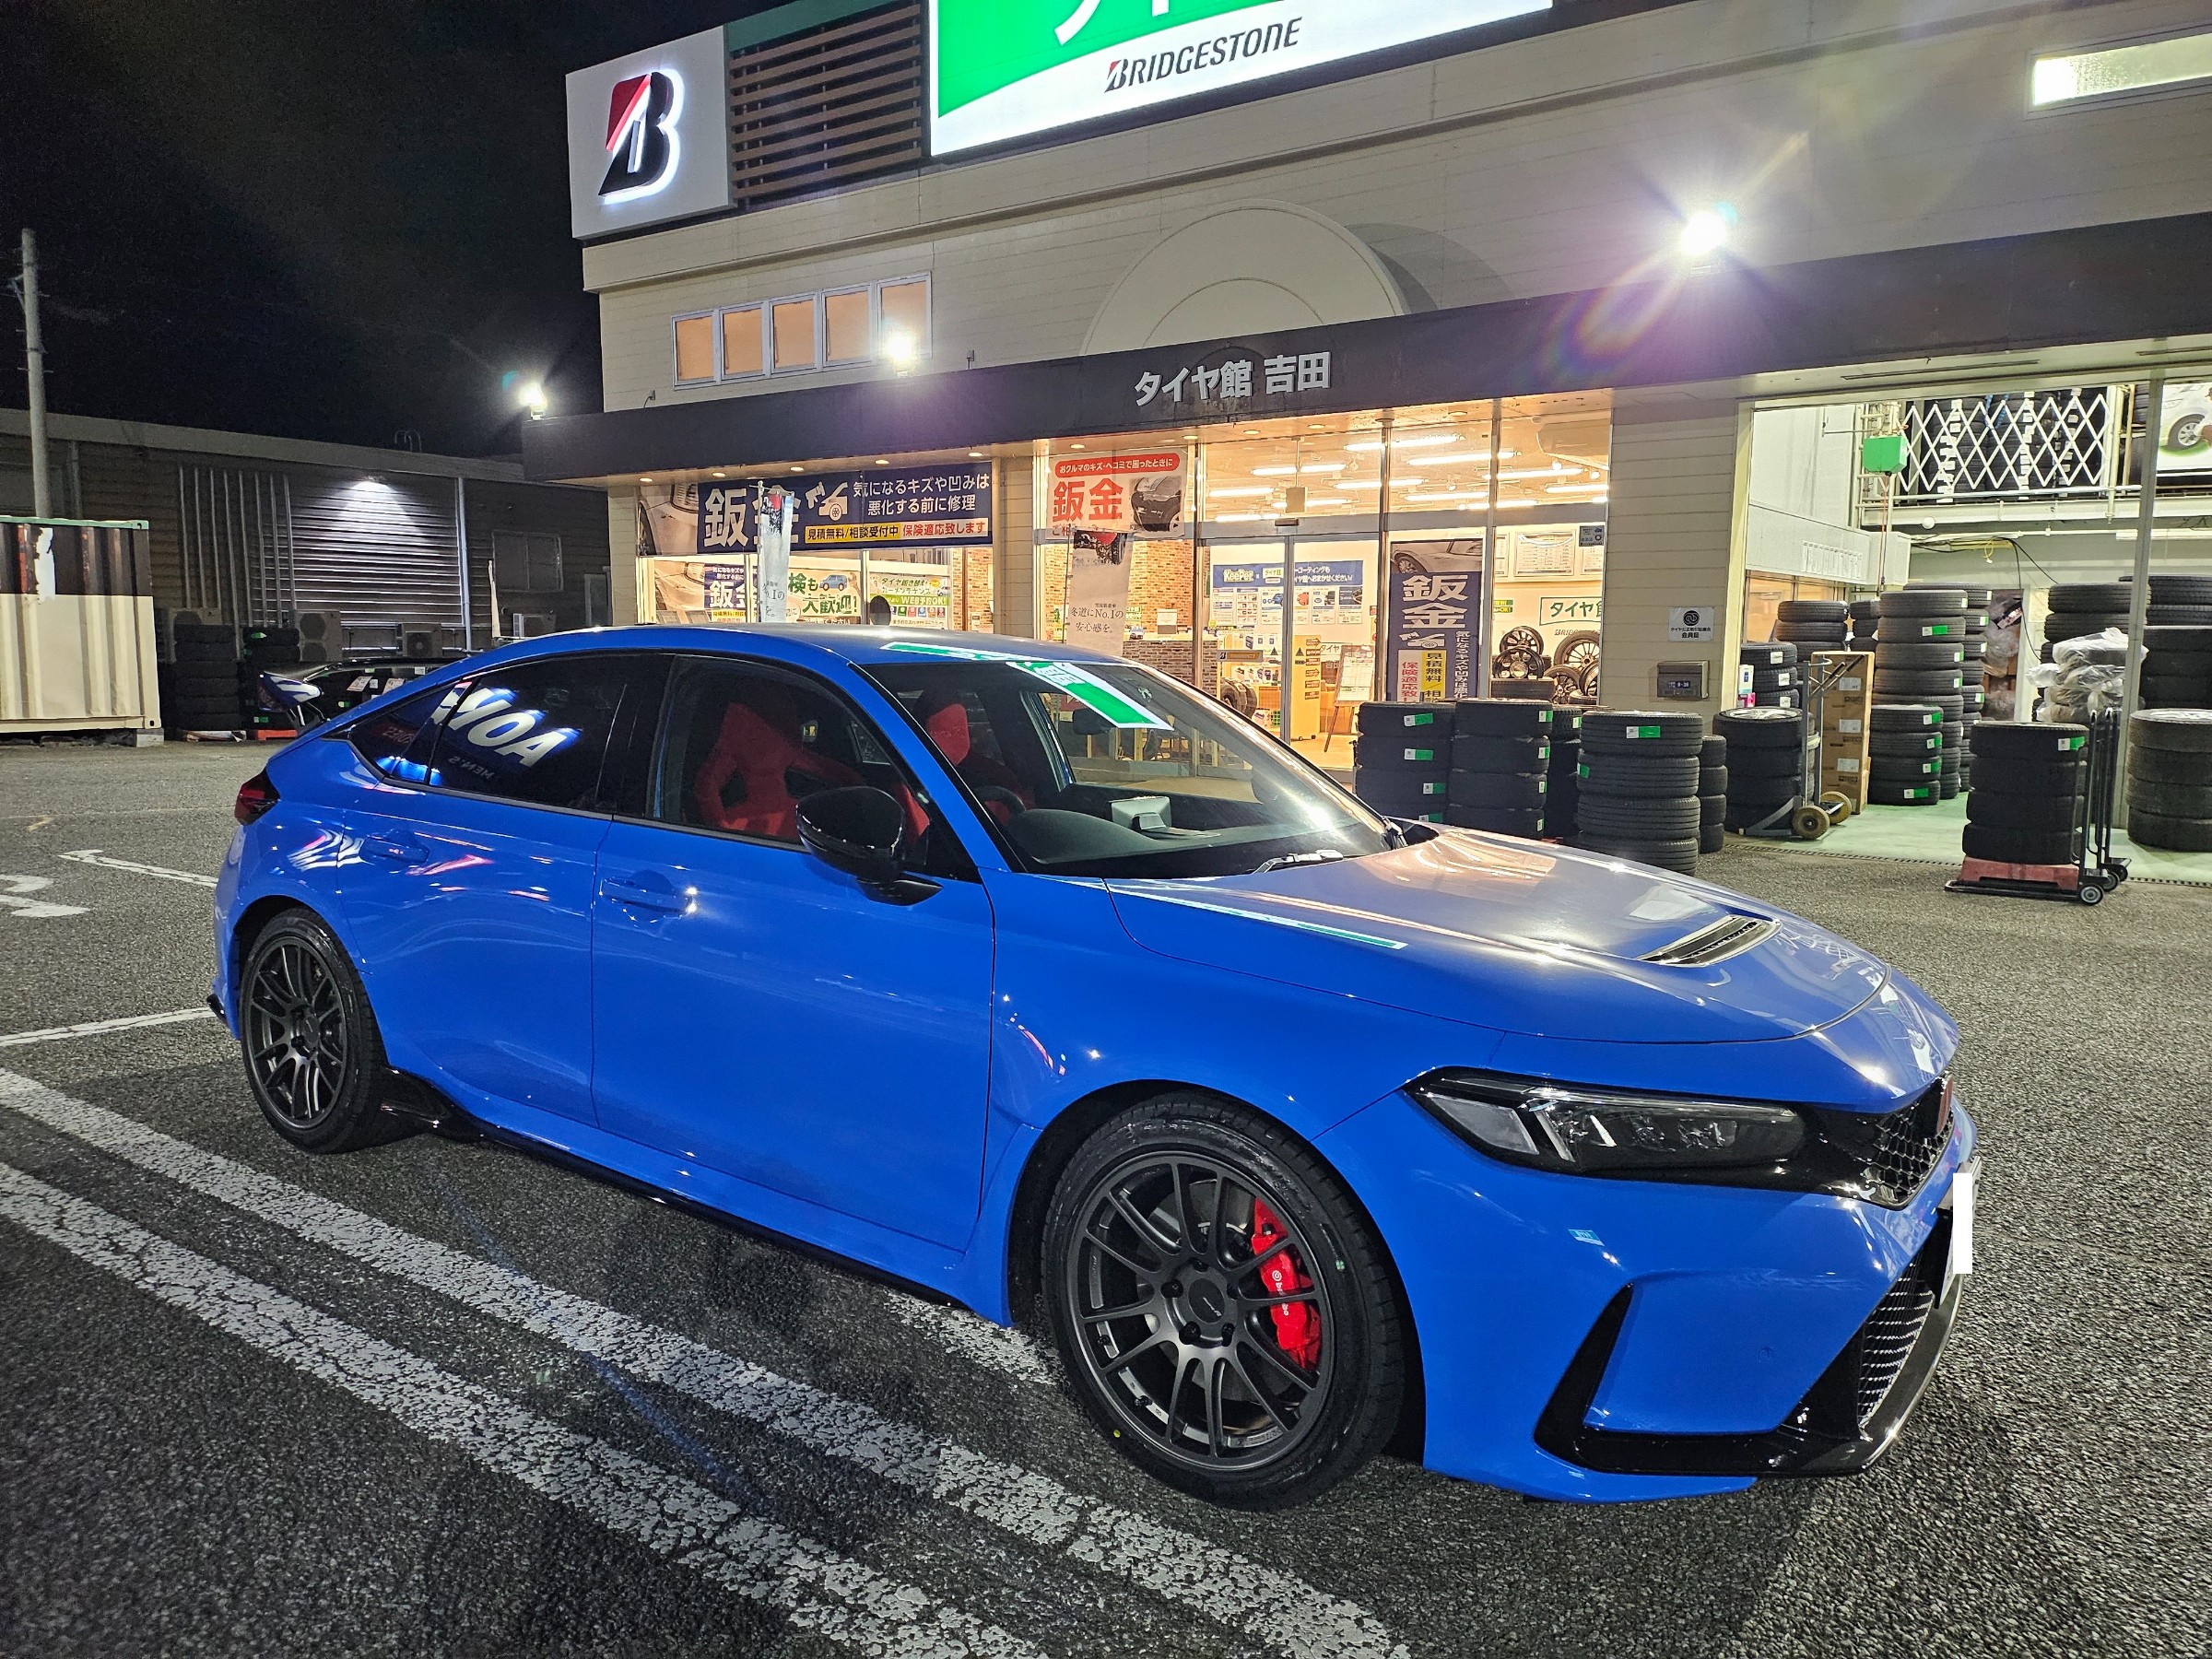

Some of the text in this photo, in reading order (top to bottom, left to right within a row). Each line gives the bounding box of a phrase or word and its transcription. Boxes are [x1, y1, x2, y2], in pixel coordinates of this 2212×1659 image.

[1105, 17, 1303, 92] BRIDGESTONE
[1135, 351, 1331, 406] タイヤ館 吉田
[1059, 458, 1173, 474] おクルマのキズ・ヘコミで困ったときに
[853, 474, 990, 498] 気になるキズや凹みは
[867, 494, 976, 516] 悪化する前に修理
[1053, 477, 1124, 523] 鈑金
[807, 522, 985, 541] 見積無料/相談受付中 保険適応致します
[1223, 569, 1254, 582] KeePer
[1295, 574, 1353, 582] イヤ館へおまかせください!
[1071, 606, 1124, 619] 冬道にNo.1の
[1402, 575, 1468, 629] 鈑金
[1453, 630, 1471, 699] 気になるキズや凹みは悪化
